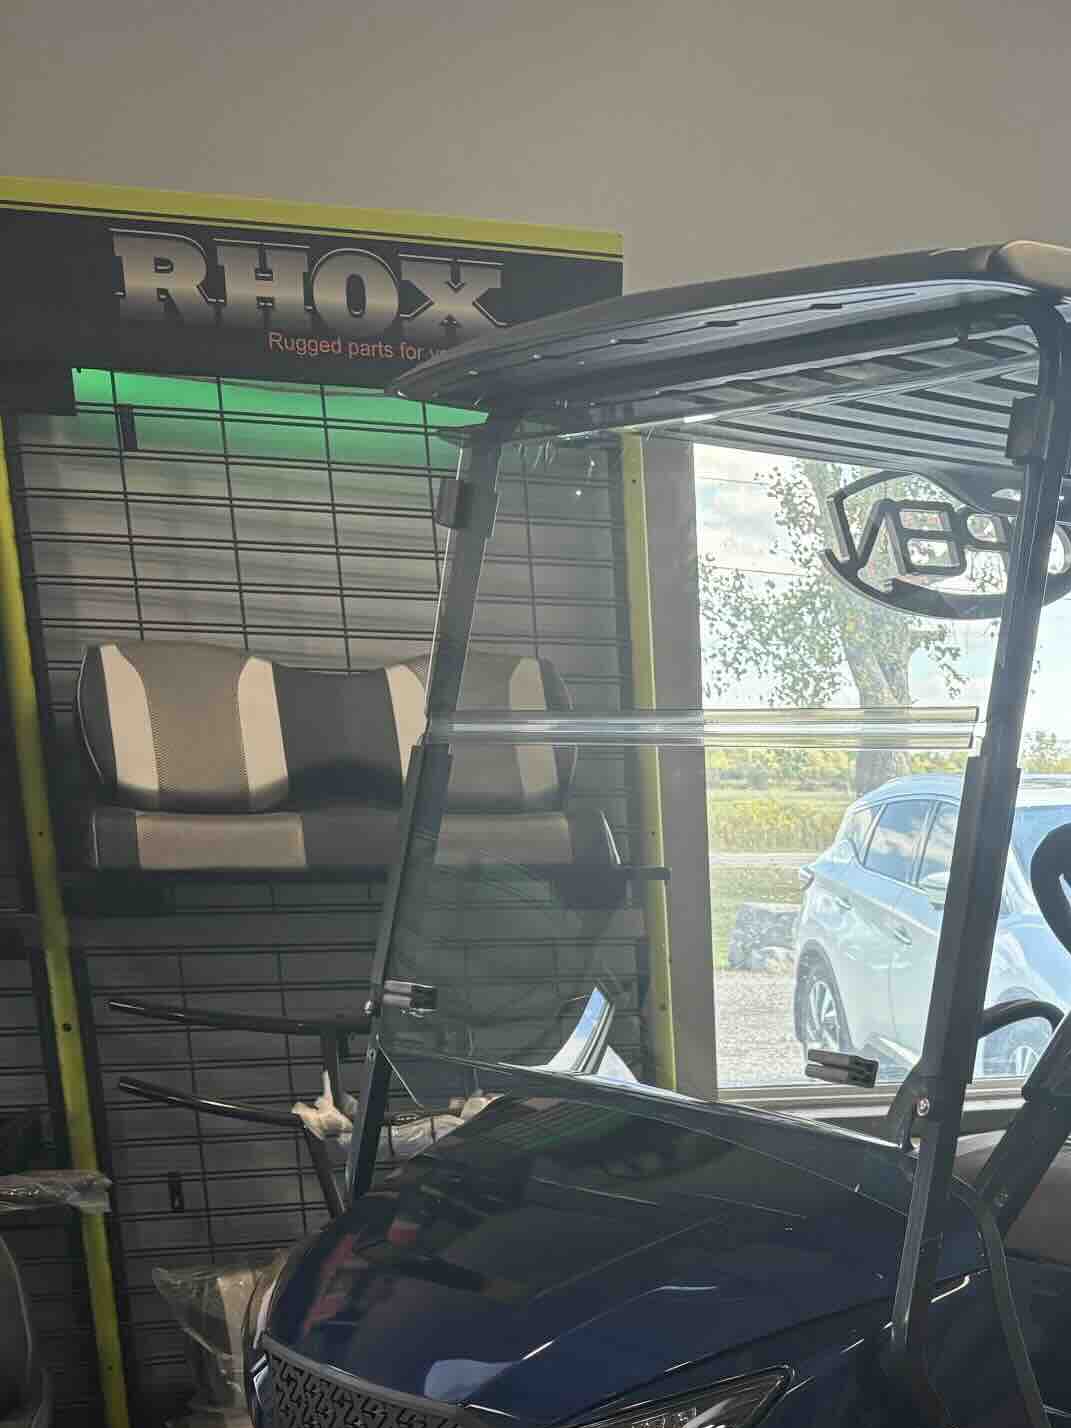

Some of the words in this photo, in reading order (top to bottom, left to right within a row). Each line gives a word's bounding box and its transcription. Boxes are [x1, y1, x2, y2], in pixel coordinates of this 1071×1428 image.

[108, 228, 508, 335] RHOX
[268, 331, 342, 357] Rugged
[348, 340, 394, 362] parts
[400, 341, 423, 361] for
